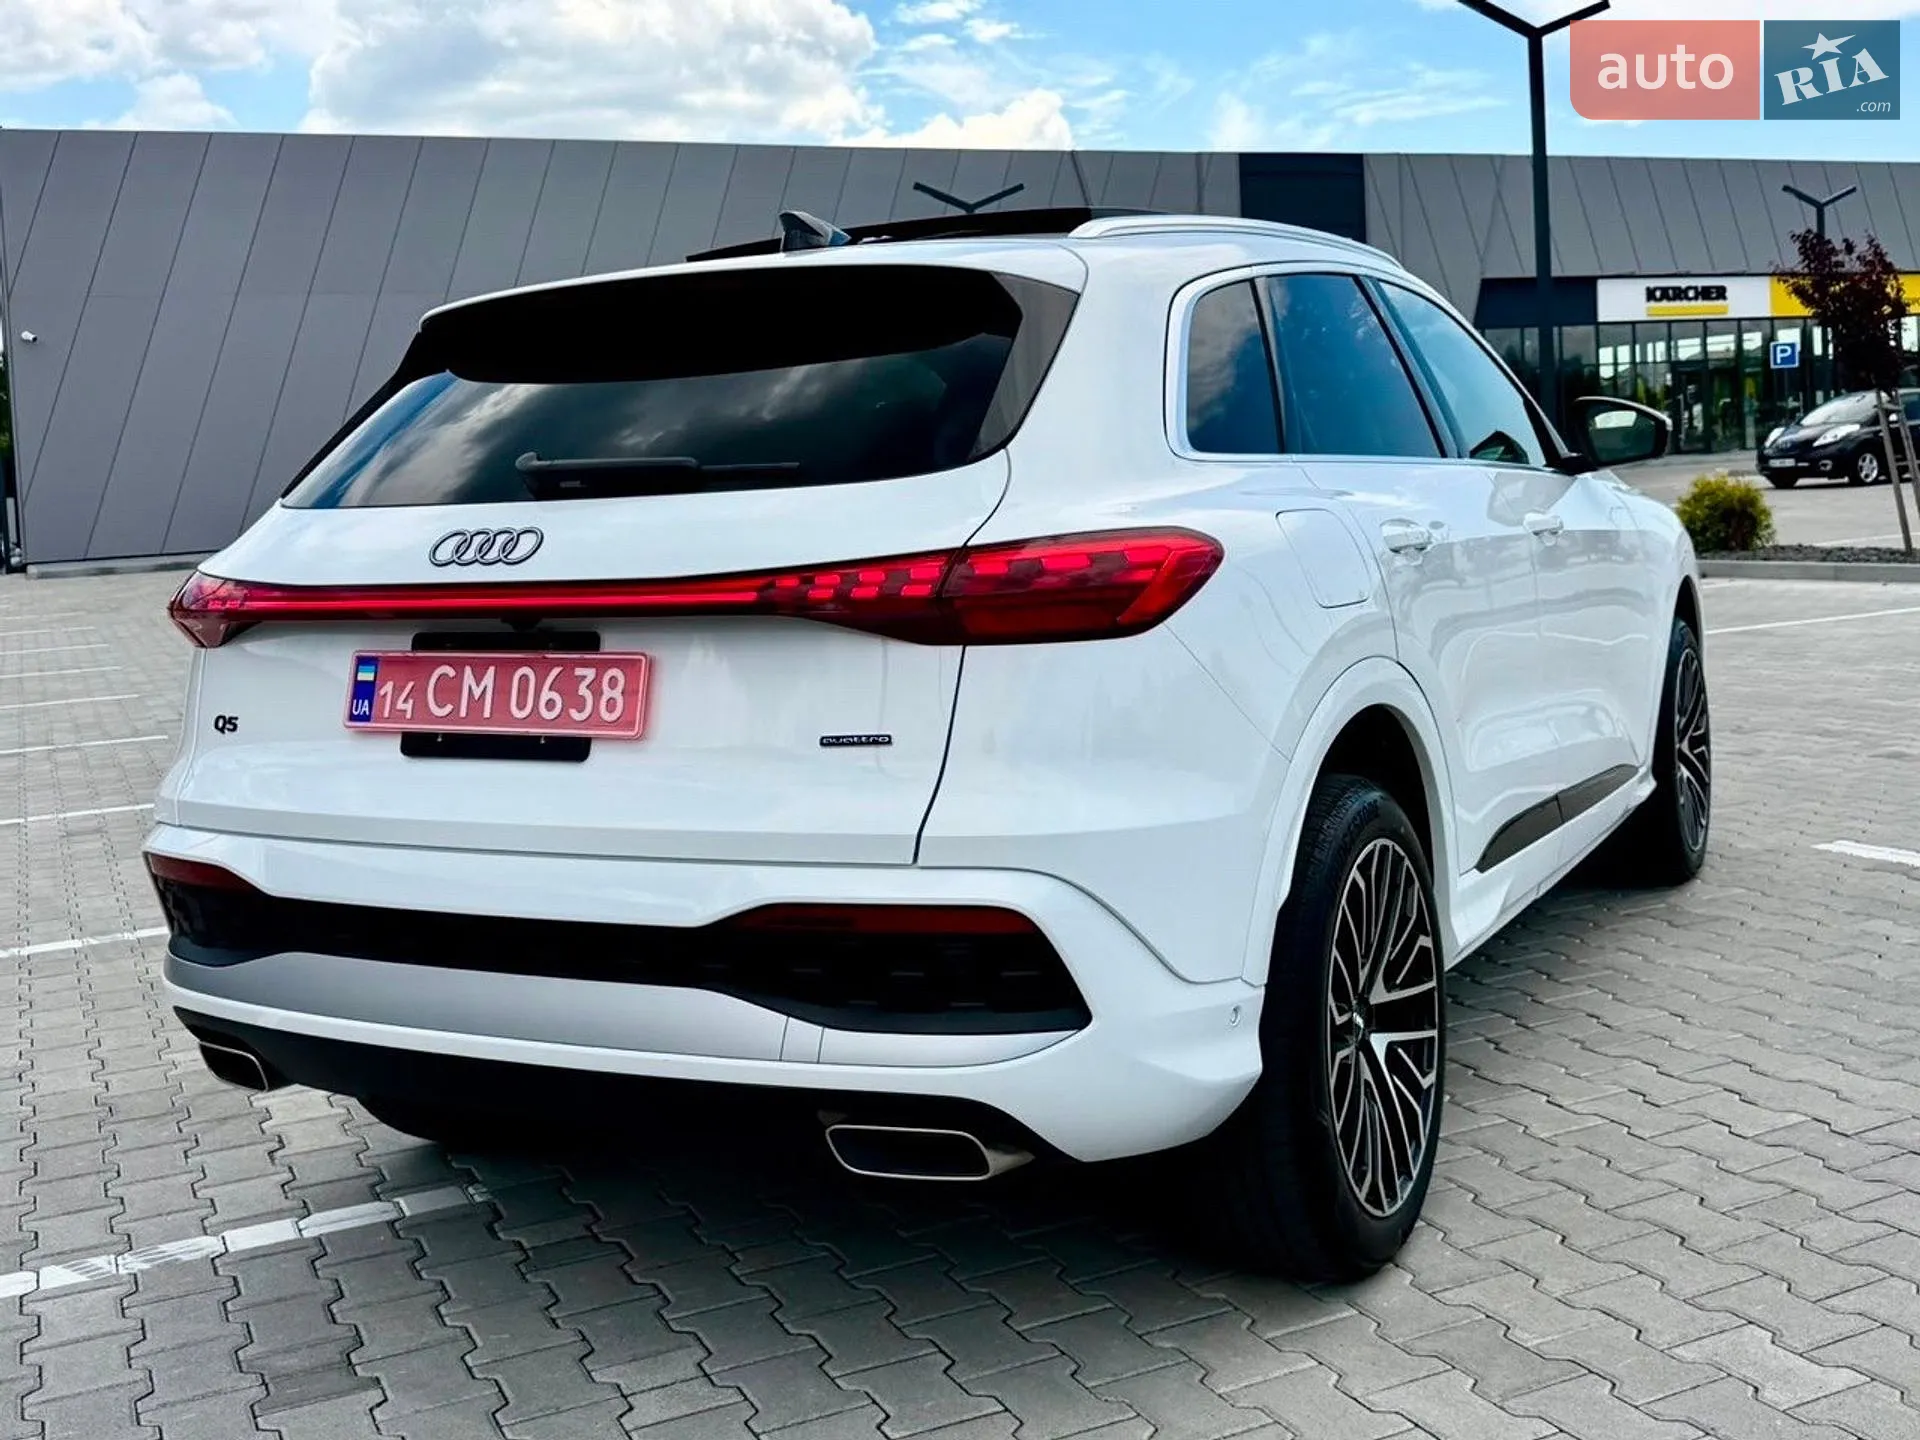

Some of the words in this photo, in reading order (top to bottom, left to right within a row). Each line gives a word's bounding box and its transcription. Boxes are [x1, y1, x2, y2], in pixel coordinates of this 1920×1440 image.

[1775, 345, 1792, 364] P
[379, 681, 415, 719] 14
[427, 664, 496, 719] CM
[509, 666, 625, 723] 0638
[352, 699, 370, 716] UA
[214, 714, 239, 735] Q5
[821, 735, 890, 745] quattro
